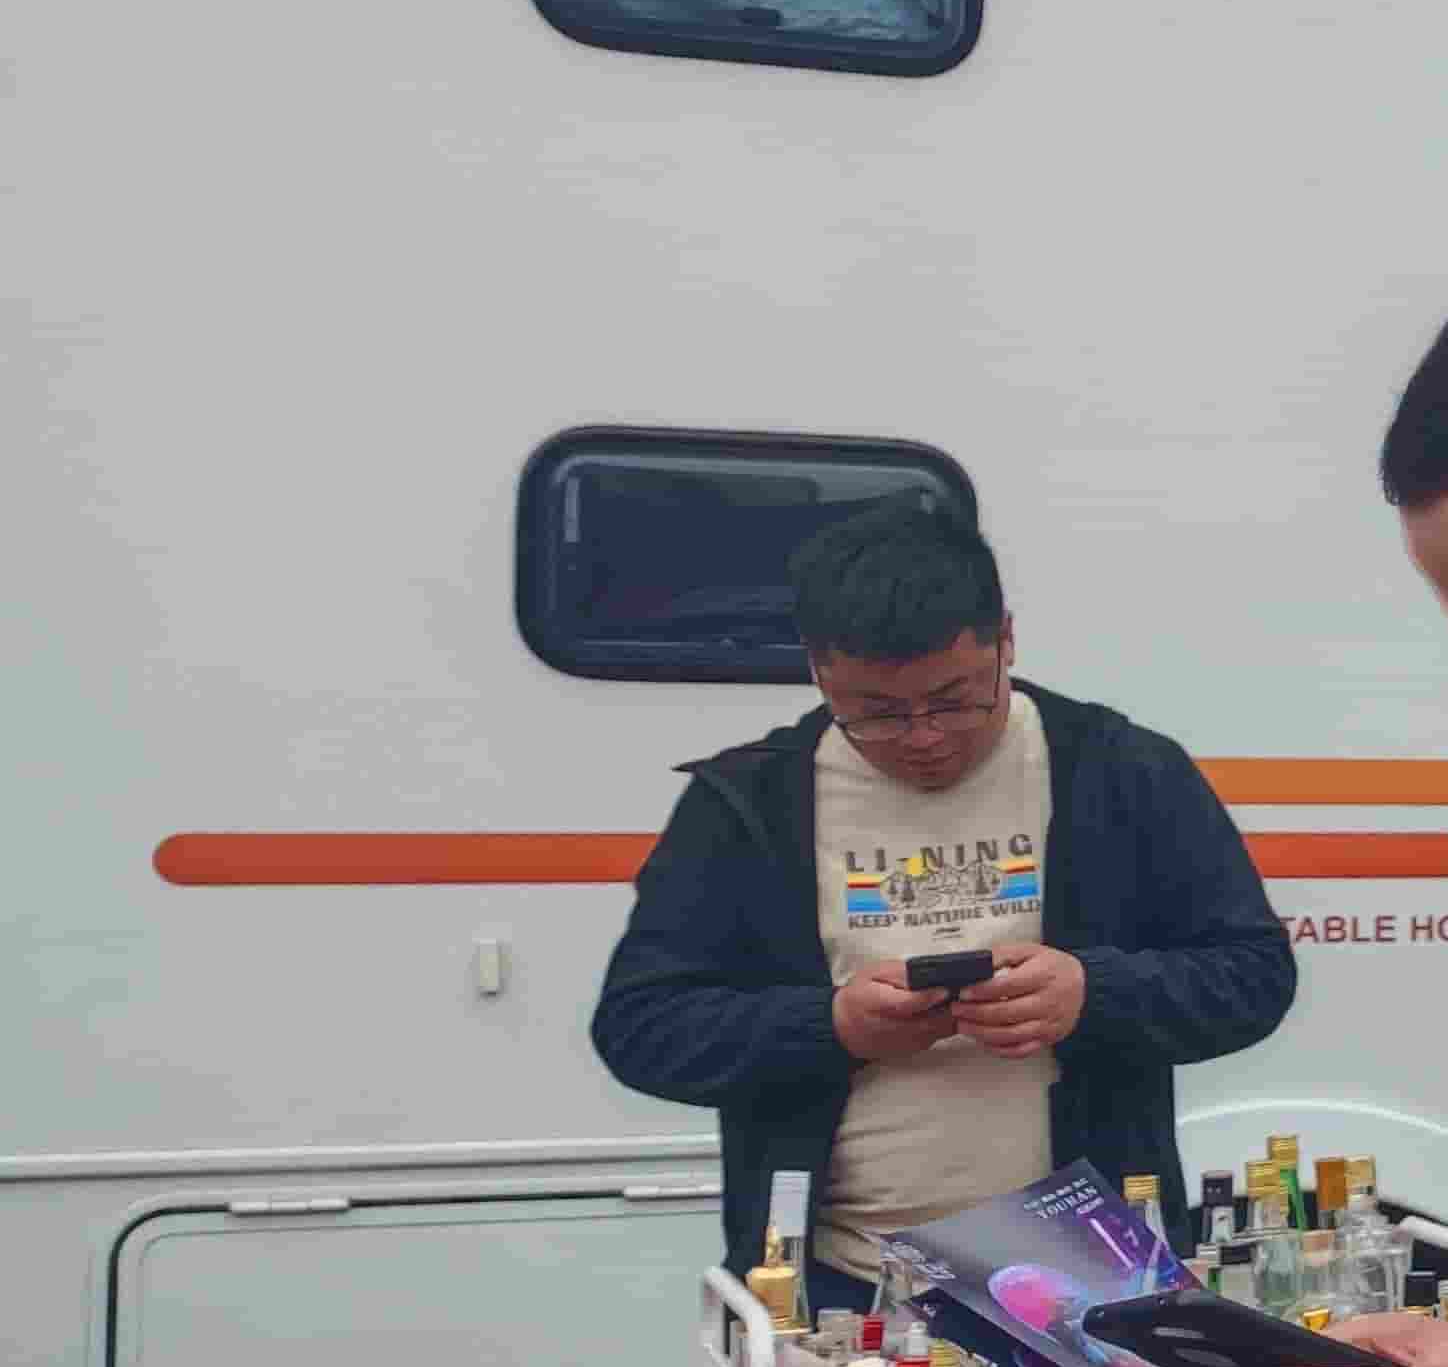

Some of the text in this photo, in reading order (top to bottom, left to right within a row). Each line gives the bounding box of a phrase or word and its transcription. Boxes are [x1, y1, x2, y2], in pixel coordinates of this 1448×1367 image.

[847, 897, 1042, 930] KEEP NATURE WILD
